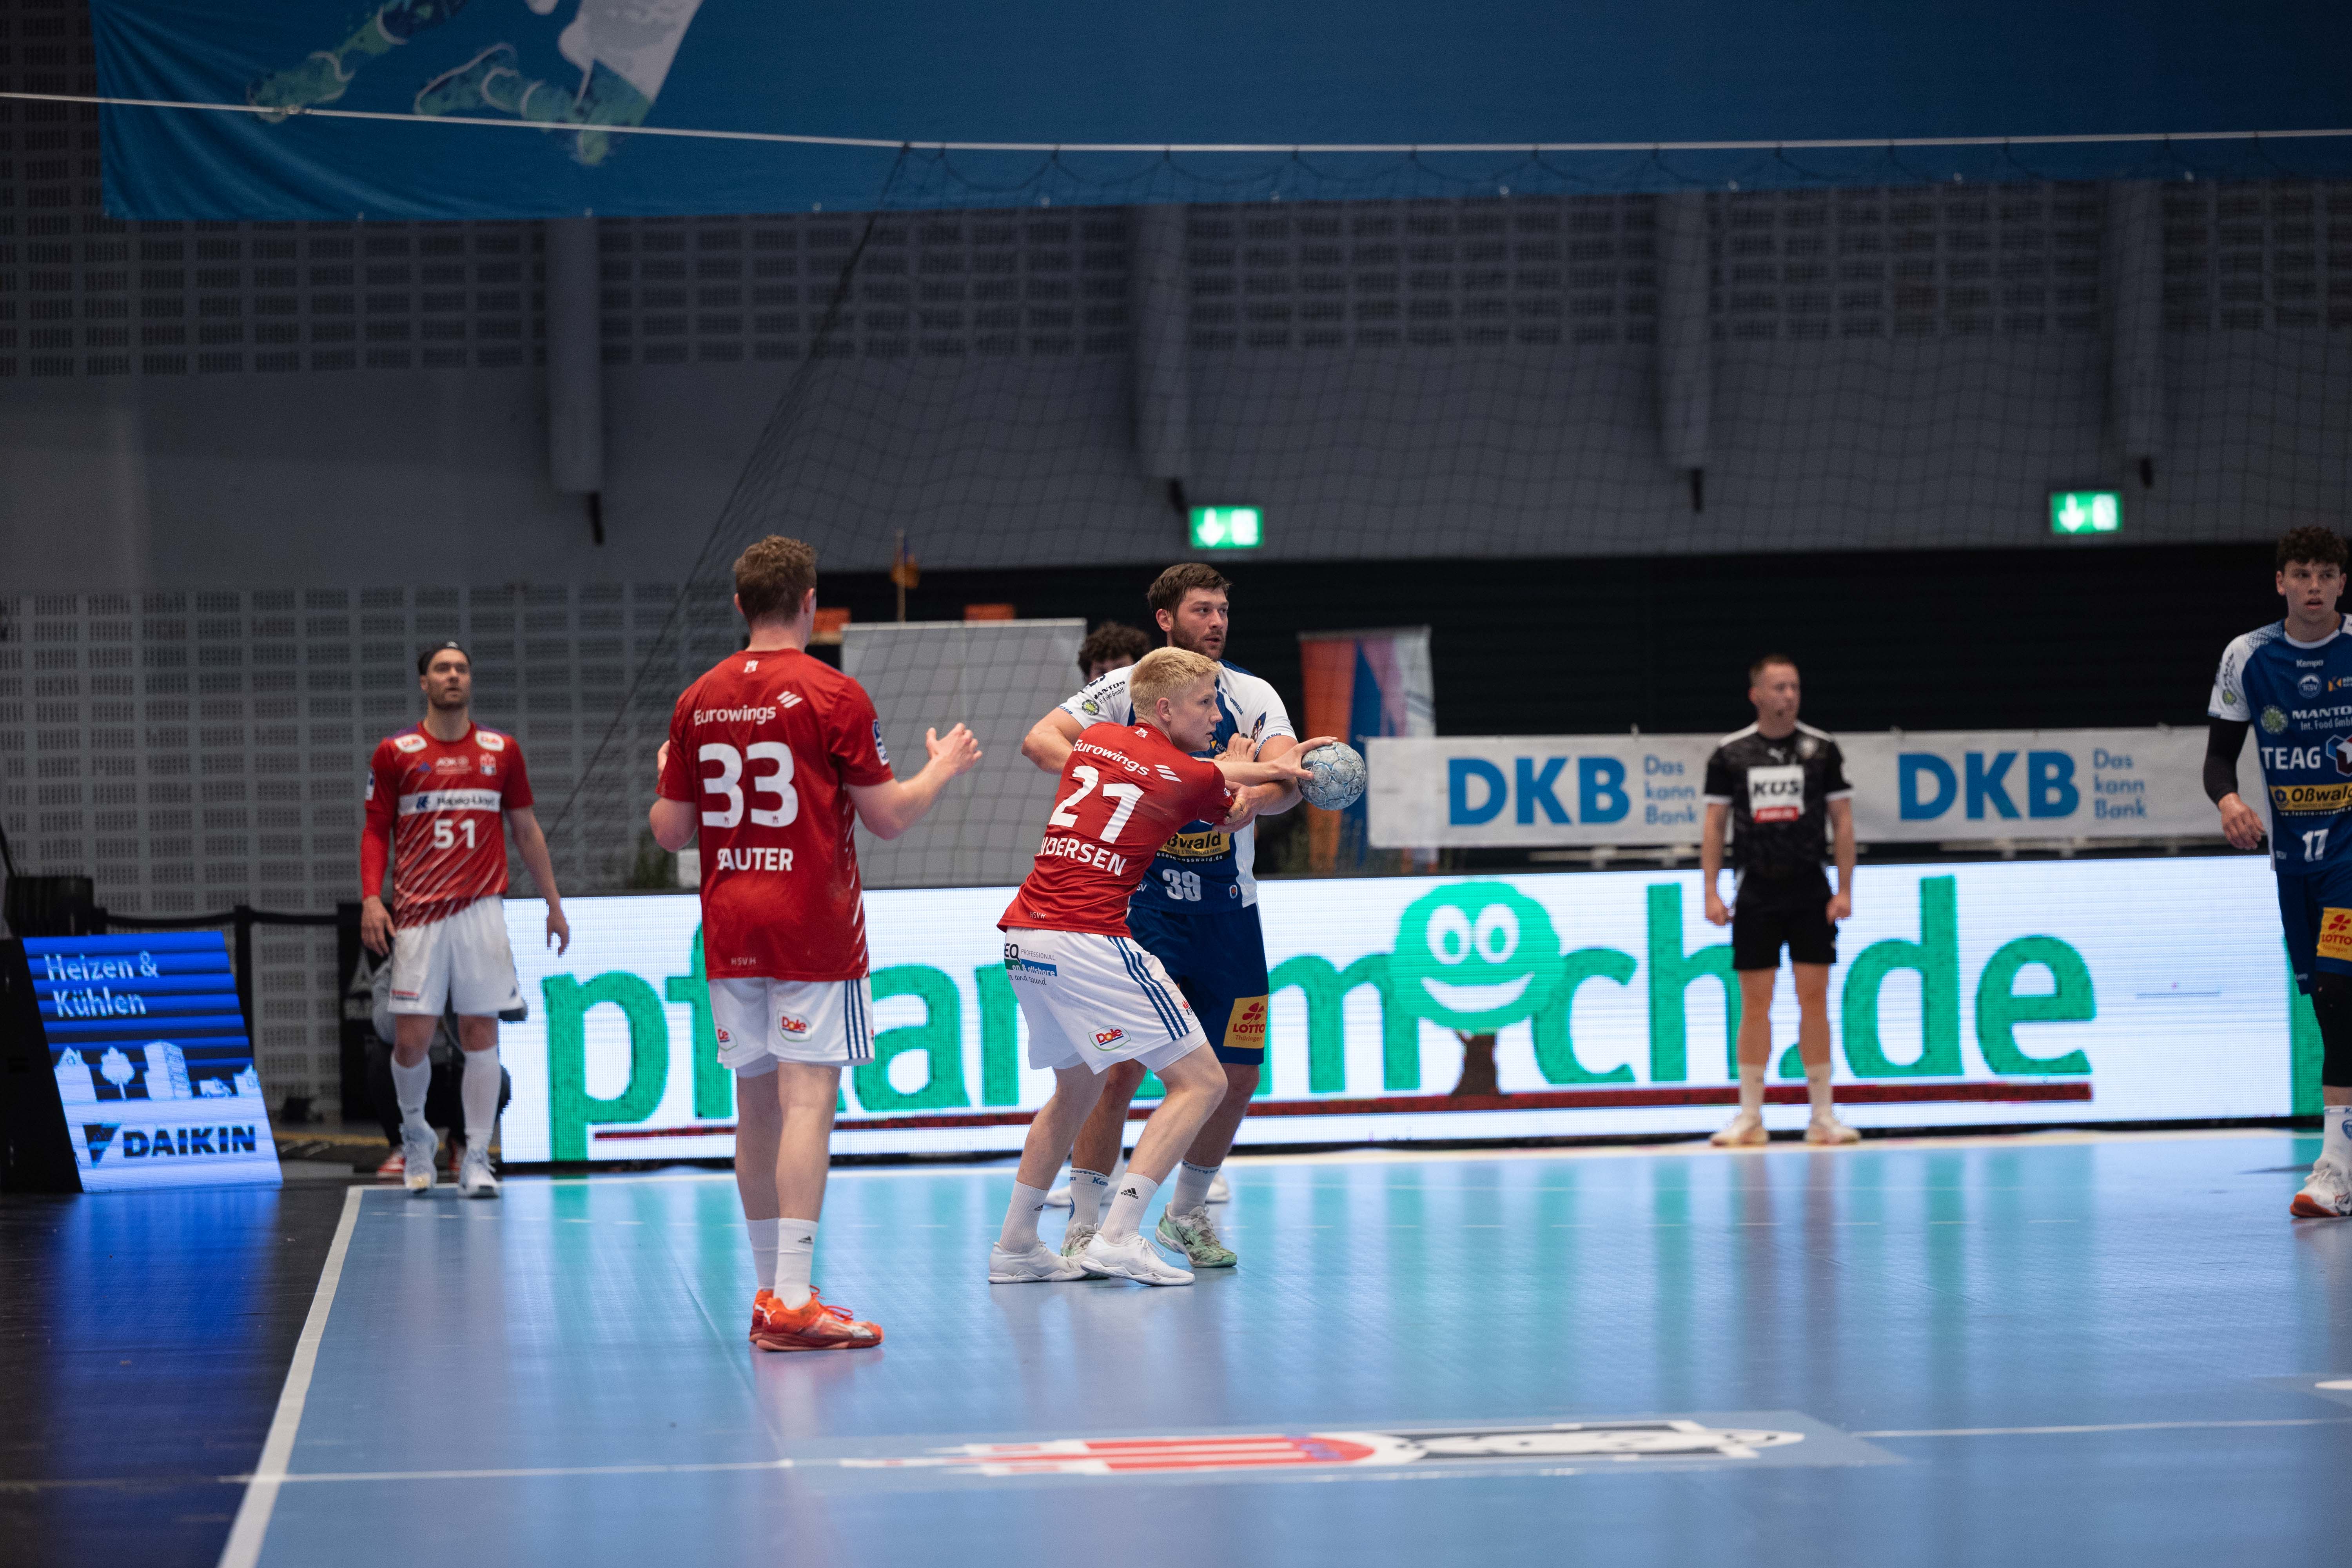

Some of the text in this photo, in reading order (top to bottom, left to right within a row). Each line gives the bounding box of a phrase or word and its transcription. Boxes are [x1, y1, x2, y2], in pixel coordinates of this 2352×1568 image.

[694, 705, 776, 726] Eurowings
[2292, 705, 2352, 719] MANTO
[2315, 719, 2333, 730] Food
[1073, 739, 1150, 777] Eurowings
[1645, 755, 1684, 776] Das
[2093, 749, 2134, 769] Das
[2261, 746, 2321, 769] TEAG
[698, 741, 799, 828] 33
[1448, 756, 1630, 826] DKB
[1646, 782, 1695, 802] kann
[1898, 751, 2080, 820] DKB
[2094, 775, 2145, 795] kann
[1049, 766, 1145, 844] 27
[1646, 805, 1697, 825] Bank
[2094, 799, 2147, 820] Bank
[434, 819, 475, 849] 51
[1167, 833, 1221, 849] ßwald
[2302, 828, 2329, 862] 17
[1036, 837, 1127, 876] NDERSEN
[1163, 869, 1201, 902] 39
[2322, 934, 2352, 945] LOTTO
[1004, 943, 1056, 963] EQ PROFESSIONAL
[45, 951, 159, 982] Heizen &
[1028, 965, 1055, 976] offshore
[1015, 973, 1029, 982] and
[1029, 977, 1047, 986] sound
[53, 986, 146, 1018] Kühlen
[781, 1016, 807, 1031] Dole
[1233, 1023, 1265, 1034] LOTTO
[1096, 1029, 1123, 1044] Dole
[123, 1125, 257, 1158] DAIKIN
[1093, 1177, 1109, 1187] Kem
